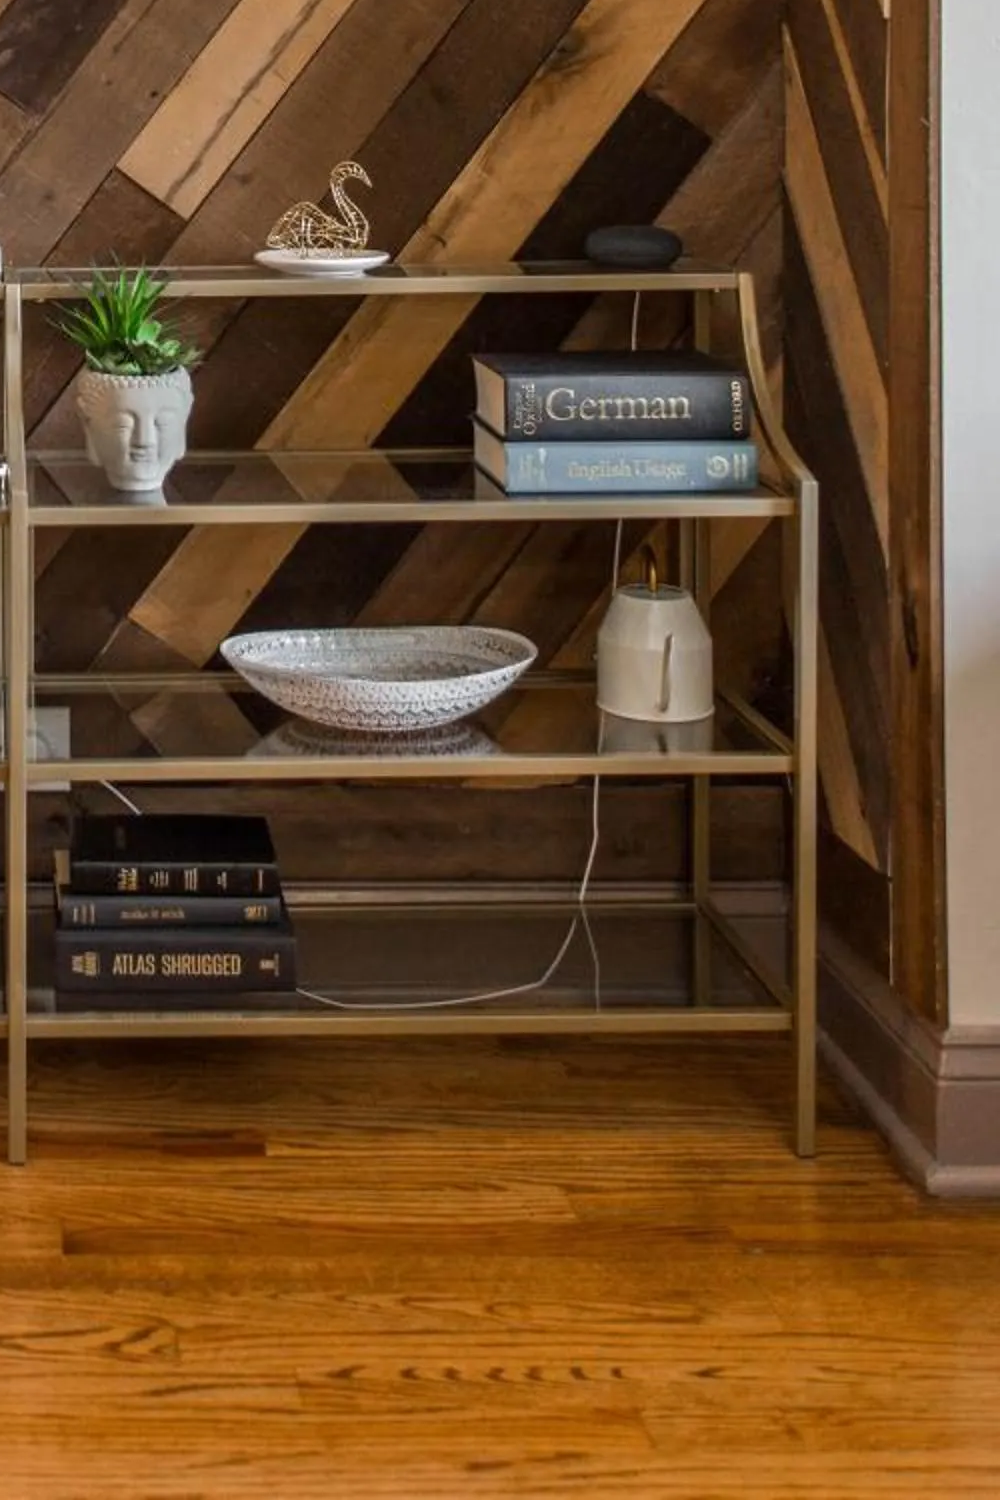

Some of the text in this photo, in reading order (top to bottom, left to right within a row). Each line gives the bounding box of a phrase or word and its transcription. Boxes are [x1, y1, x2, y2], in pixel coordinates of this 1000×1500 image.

[546, 387, 692, 421] German
[112, 953, 156, 975] ATLAS
[161, 953, 242, 976] SHRUGGED
